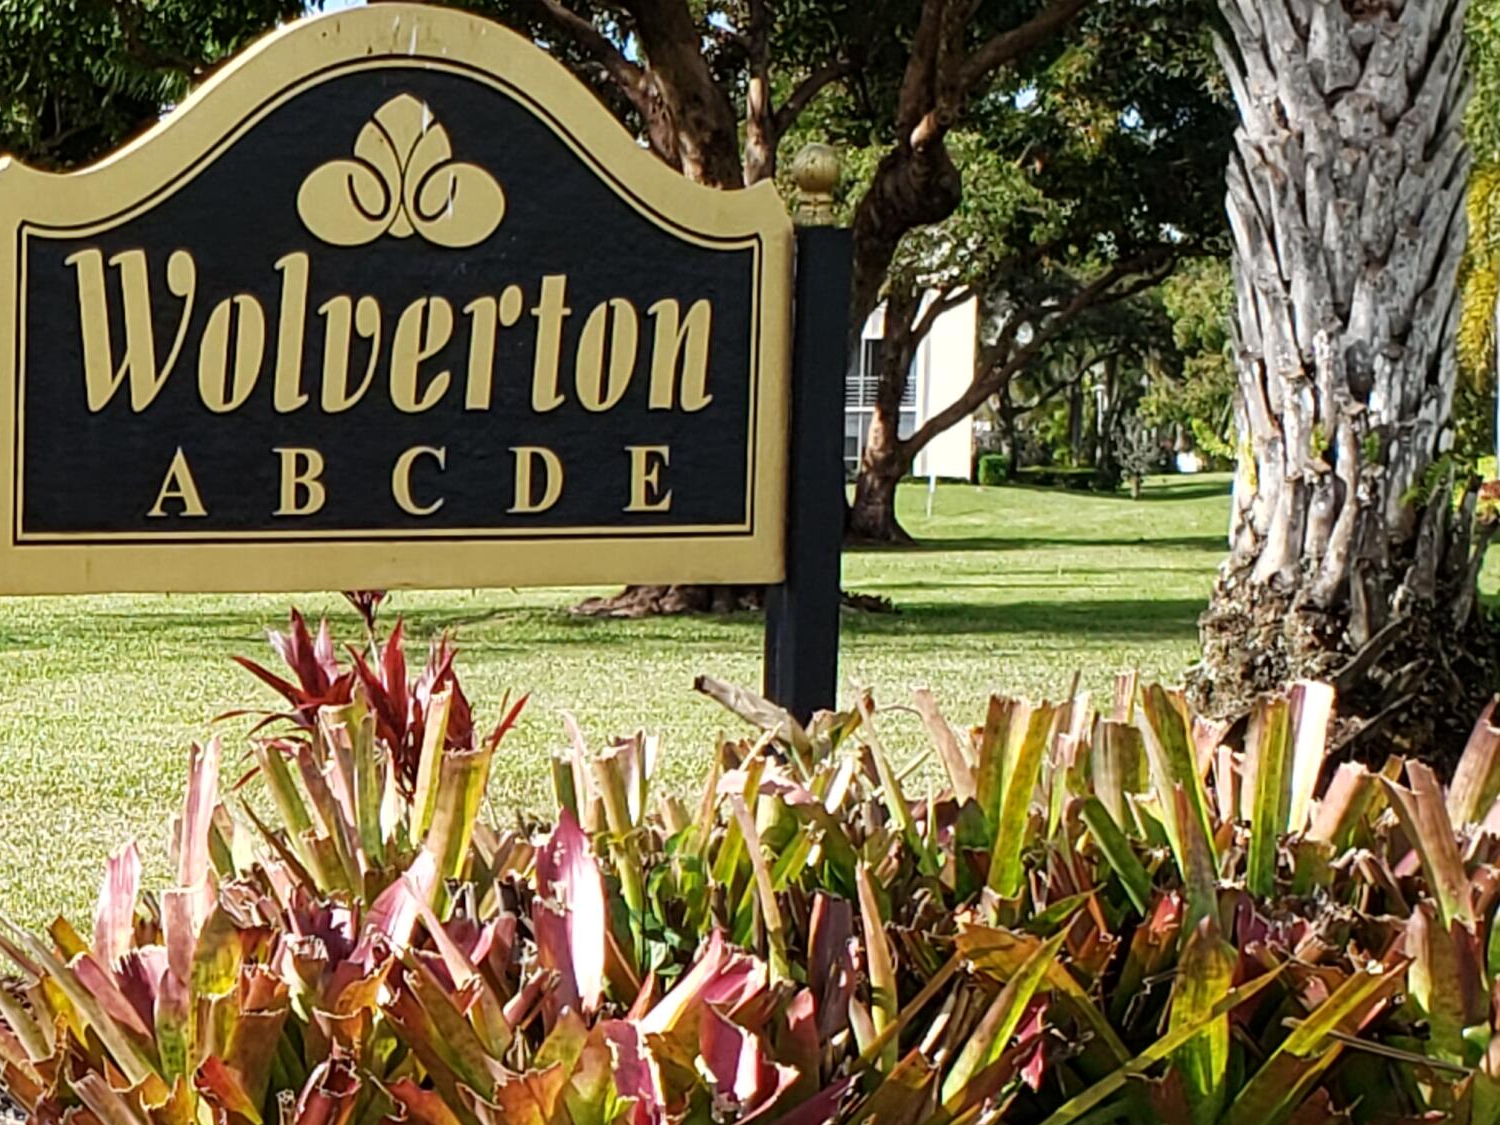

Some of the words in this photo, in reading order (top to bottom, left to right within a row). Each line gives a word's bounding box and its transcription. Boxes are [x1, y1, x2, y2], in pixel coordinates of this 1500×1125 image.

[64, 247, 713, 414] Wolverton
[147, 446, 207, 518] A
[272, 446, 327, 516] B
[392, 445, 446, 516] C
[507, 445, 564, 514] D
[623, 445, 673, 512] E
